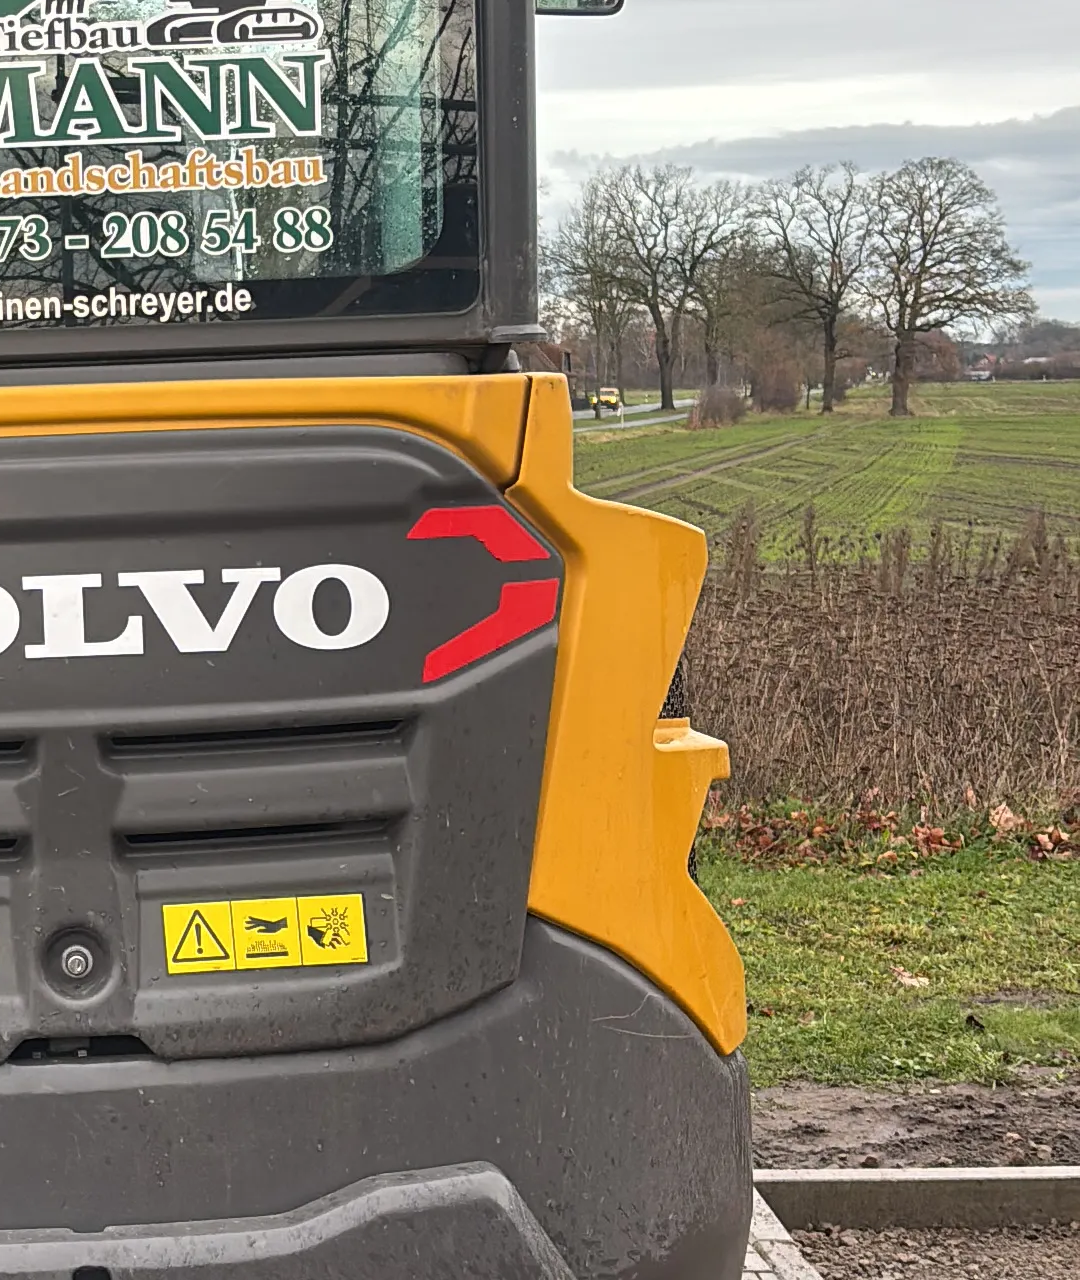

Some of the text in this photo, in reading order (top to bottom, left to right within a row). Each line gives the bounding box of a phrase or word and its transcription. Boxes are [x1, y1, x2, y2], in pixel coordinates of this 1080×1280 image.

[65, 235, 89, 249] -
[101, 213, 188, 258] 208
[202, 209, 260, 254] 54
[274, 207, 333, 252] 88
